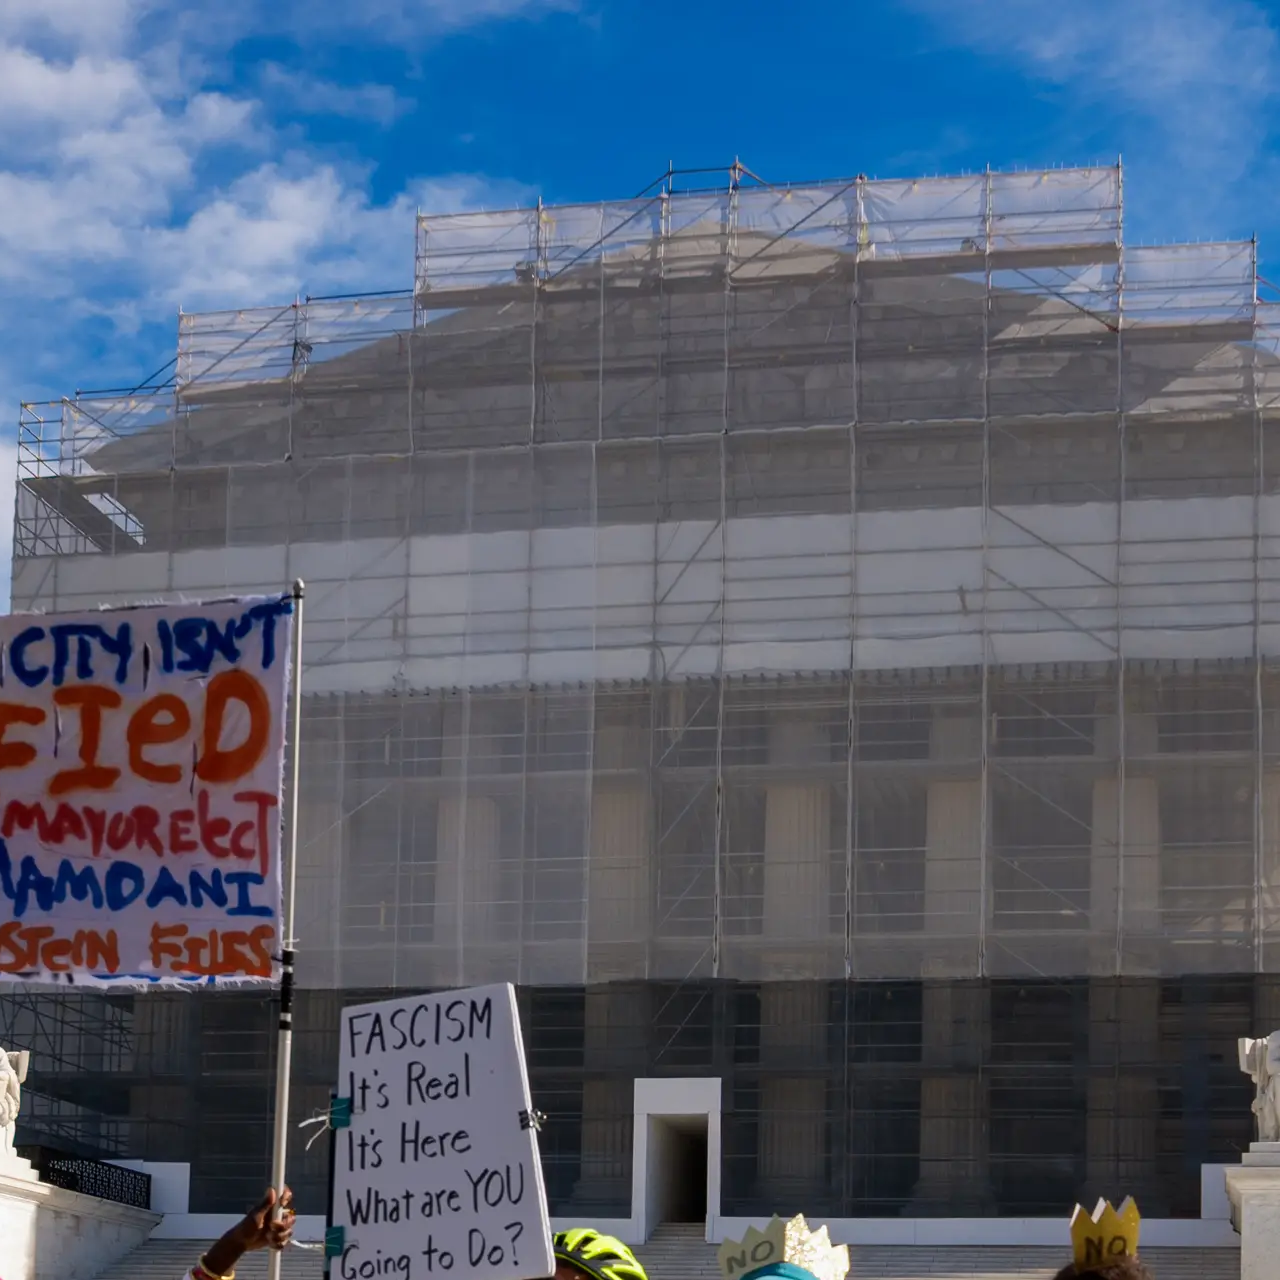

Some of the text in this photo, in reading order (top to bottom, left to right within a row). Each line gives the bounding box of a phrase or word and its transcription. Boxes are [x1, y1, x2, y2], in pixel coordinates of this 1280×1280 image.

[10, 622, 133, 687] CITY
[157, 592, 294, 674] ISN'T
[348, 997, 493, 1058] FASCISM
[349, 1052, 472, 1114] It's Real
[348, 1120, 472, 1171] It's Here
[346, 1162, 525, 1226] What are YOU
[422, 1235, 454, 1272] to
[468, 1221, 524, 1268] Do?
[725, 1239, 775, 1275] NO
[1084, 1234, 1128, 1261] NO
